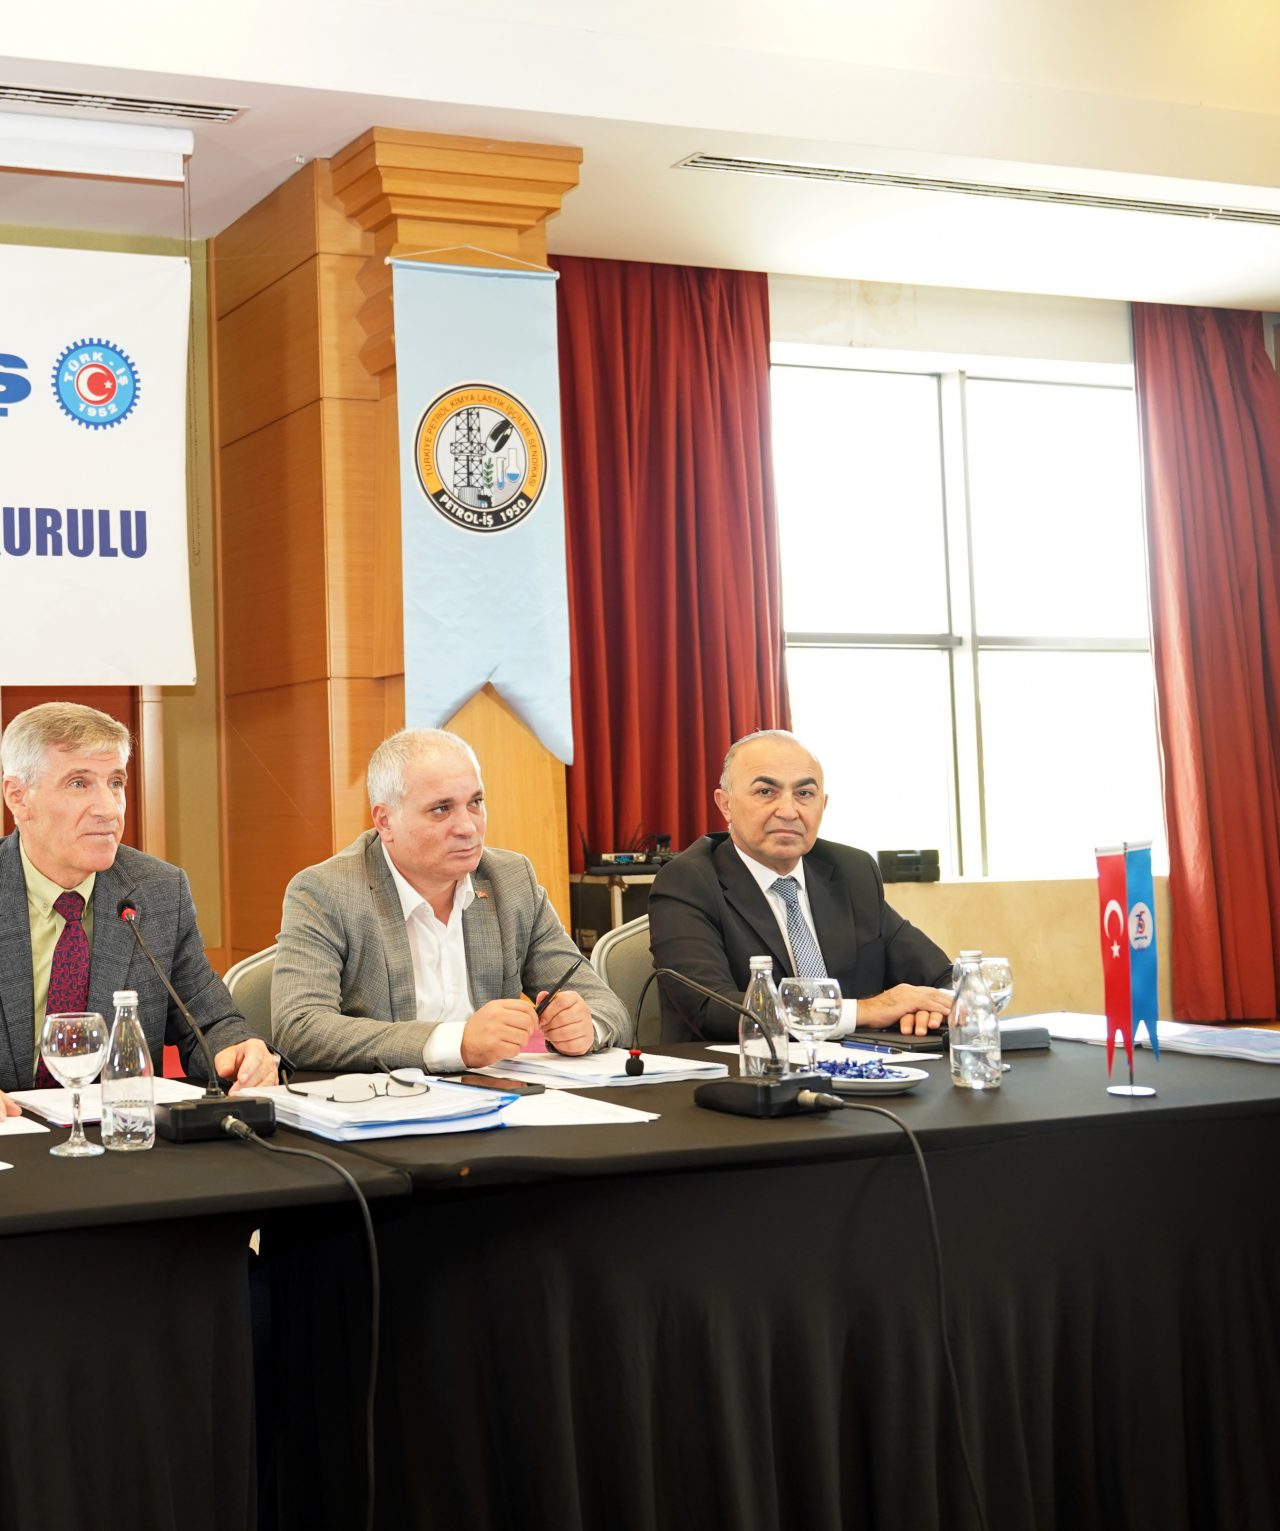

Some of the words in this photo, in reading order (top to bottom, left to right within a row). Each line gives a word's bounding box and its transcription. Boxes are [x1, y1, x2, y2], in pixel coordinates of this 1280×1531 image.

[79, 403, 118, 417] 1952
[427, 405, 451, 435] PETROL
[450, 394, 475, 407] KİMYA
[477, 395, 506, 409] LASTİK
[439, 496, 494, 527] PETROL-İŞ
[500, 499, 527, 522] 1950
